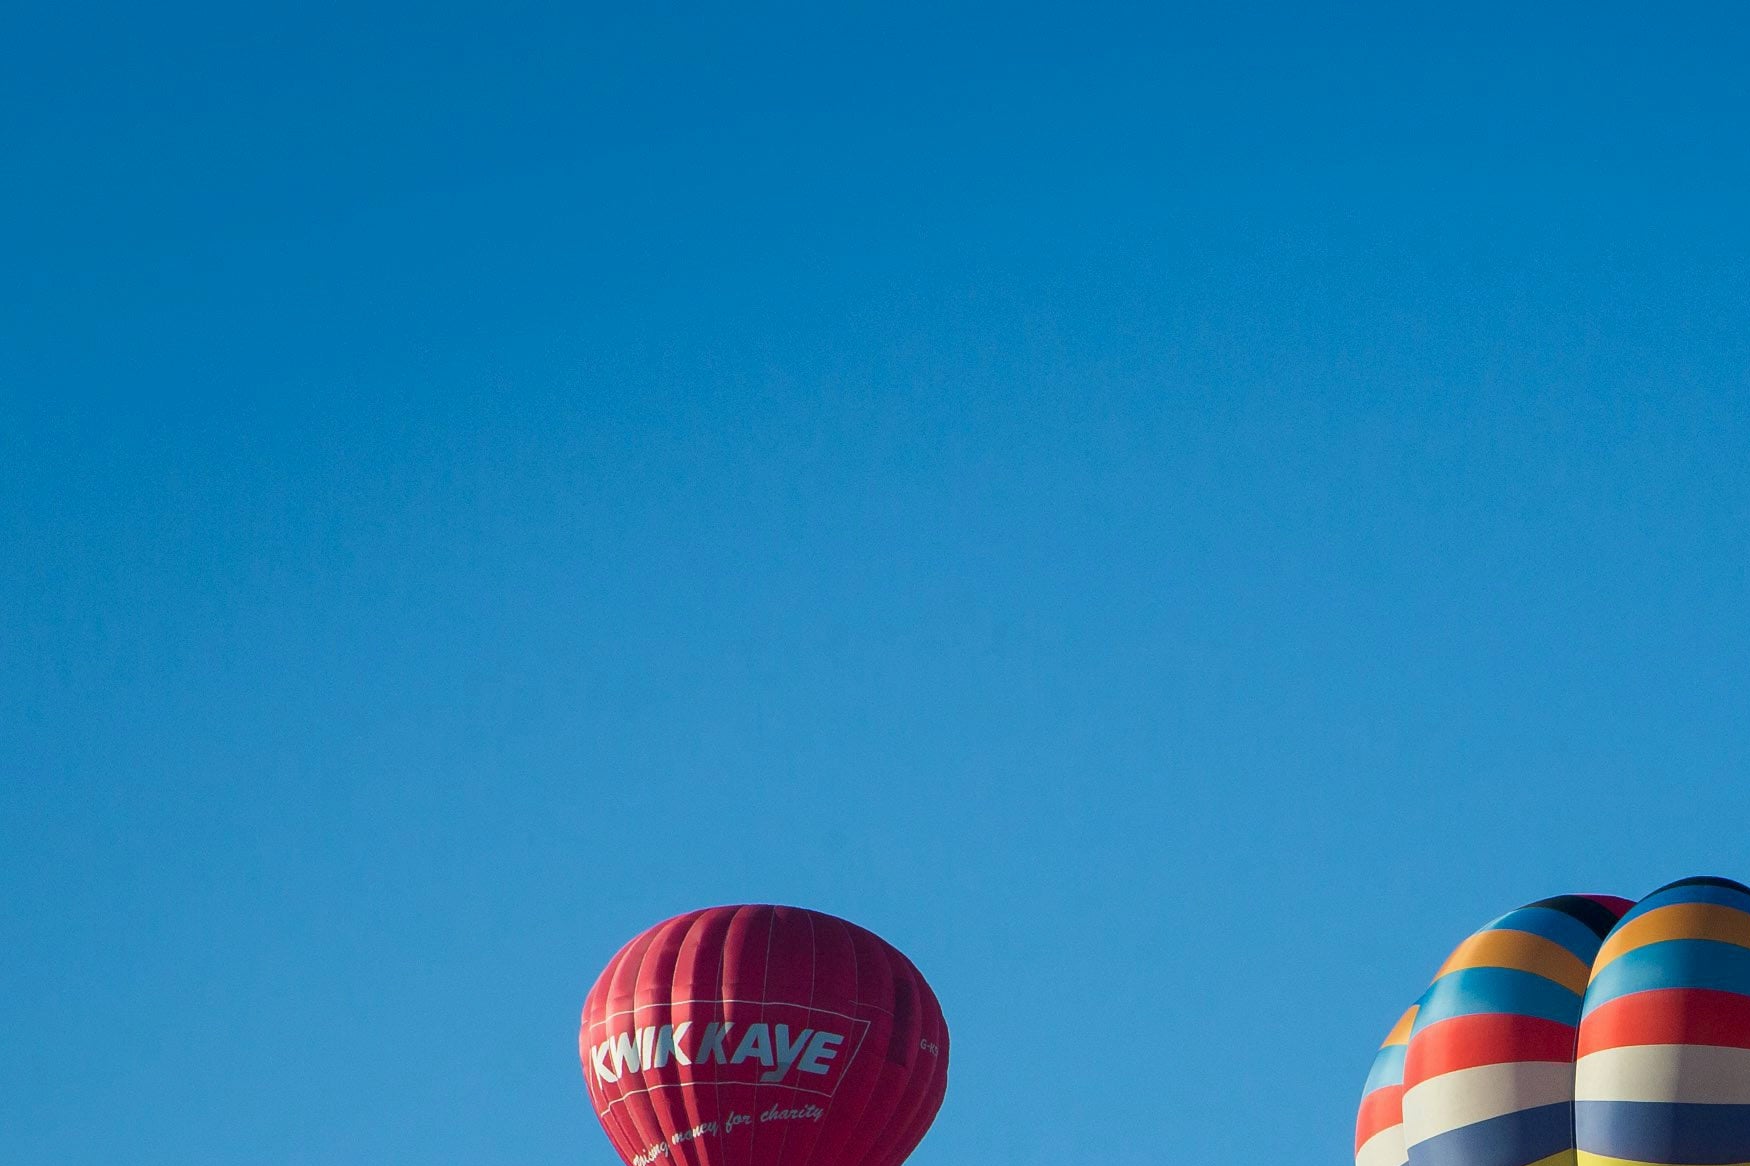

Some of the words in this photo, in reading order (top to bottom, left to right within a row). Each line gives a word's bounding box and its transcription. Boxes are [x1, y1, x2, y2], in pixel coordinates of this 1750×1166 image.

[591, 1021, 693, 1089] KWIK
[695, 1022, 844, 1082] KAYE
[672, 1119, 718, 1145] money
[726, 1111, 752, 1132] for
[760, 1103, 825, 1122] charity
